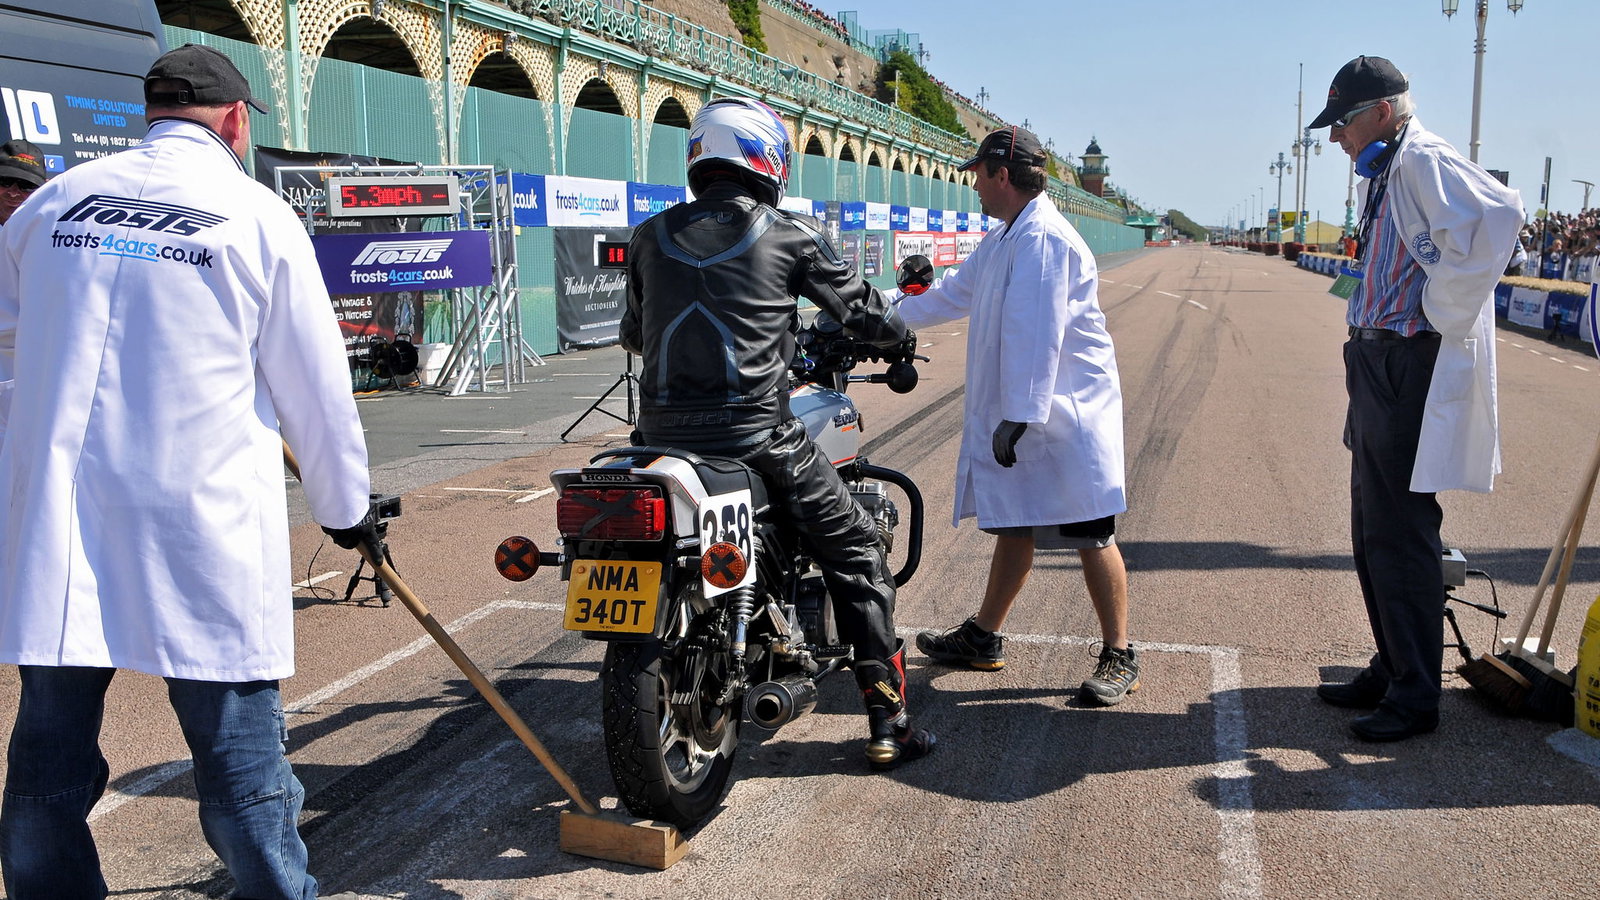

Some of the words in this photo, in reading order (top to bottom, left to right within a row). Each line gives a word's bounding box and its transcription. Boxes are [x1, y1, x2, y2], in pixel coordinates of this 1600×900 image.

[65, 95, 97, 110] TIMING
[97, 99, 145, 115] SOLUTIONS
[92, 113, 126, 128] LIMITED
[72, 132, 84, 143] Tel
[85, 134, 98, 144] +44
[110, 136, 126, 146] 1827
[556, 190, 620, 212] frosts4cars.co.uk
[51, 230, 214, 269] frosts4cars.co.uk
[350, 266, 453, 283] frosts4cars.co.uk
[564, 276, 588, 295] Watches
[588, 274, 599, 299] of
[585, 301, 618, 312] AUCTIONEERS
[585, 474, 633, 482] HONDA
[588, 566, 639, 592] NMA
[574, 598, 646, 626] 340T
